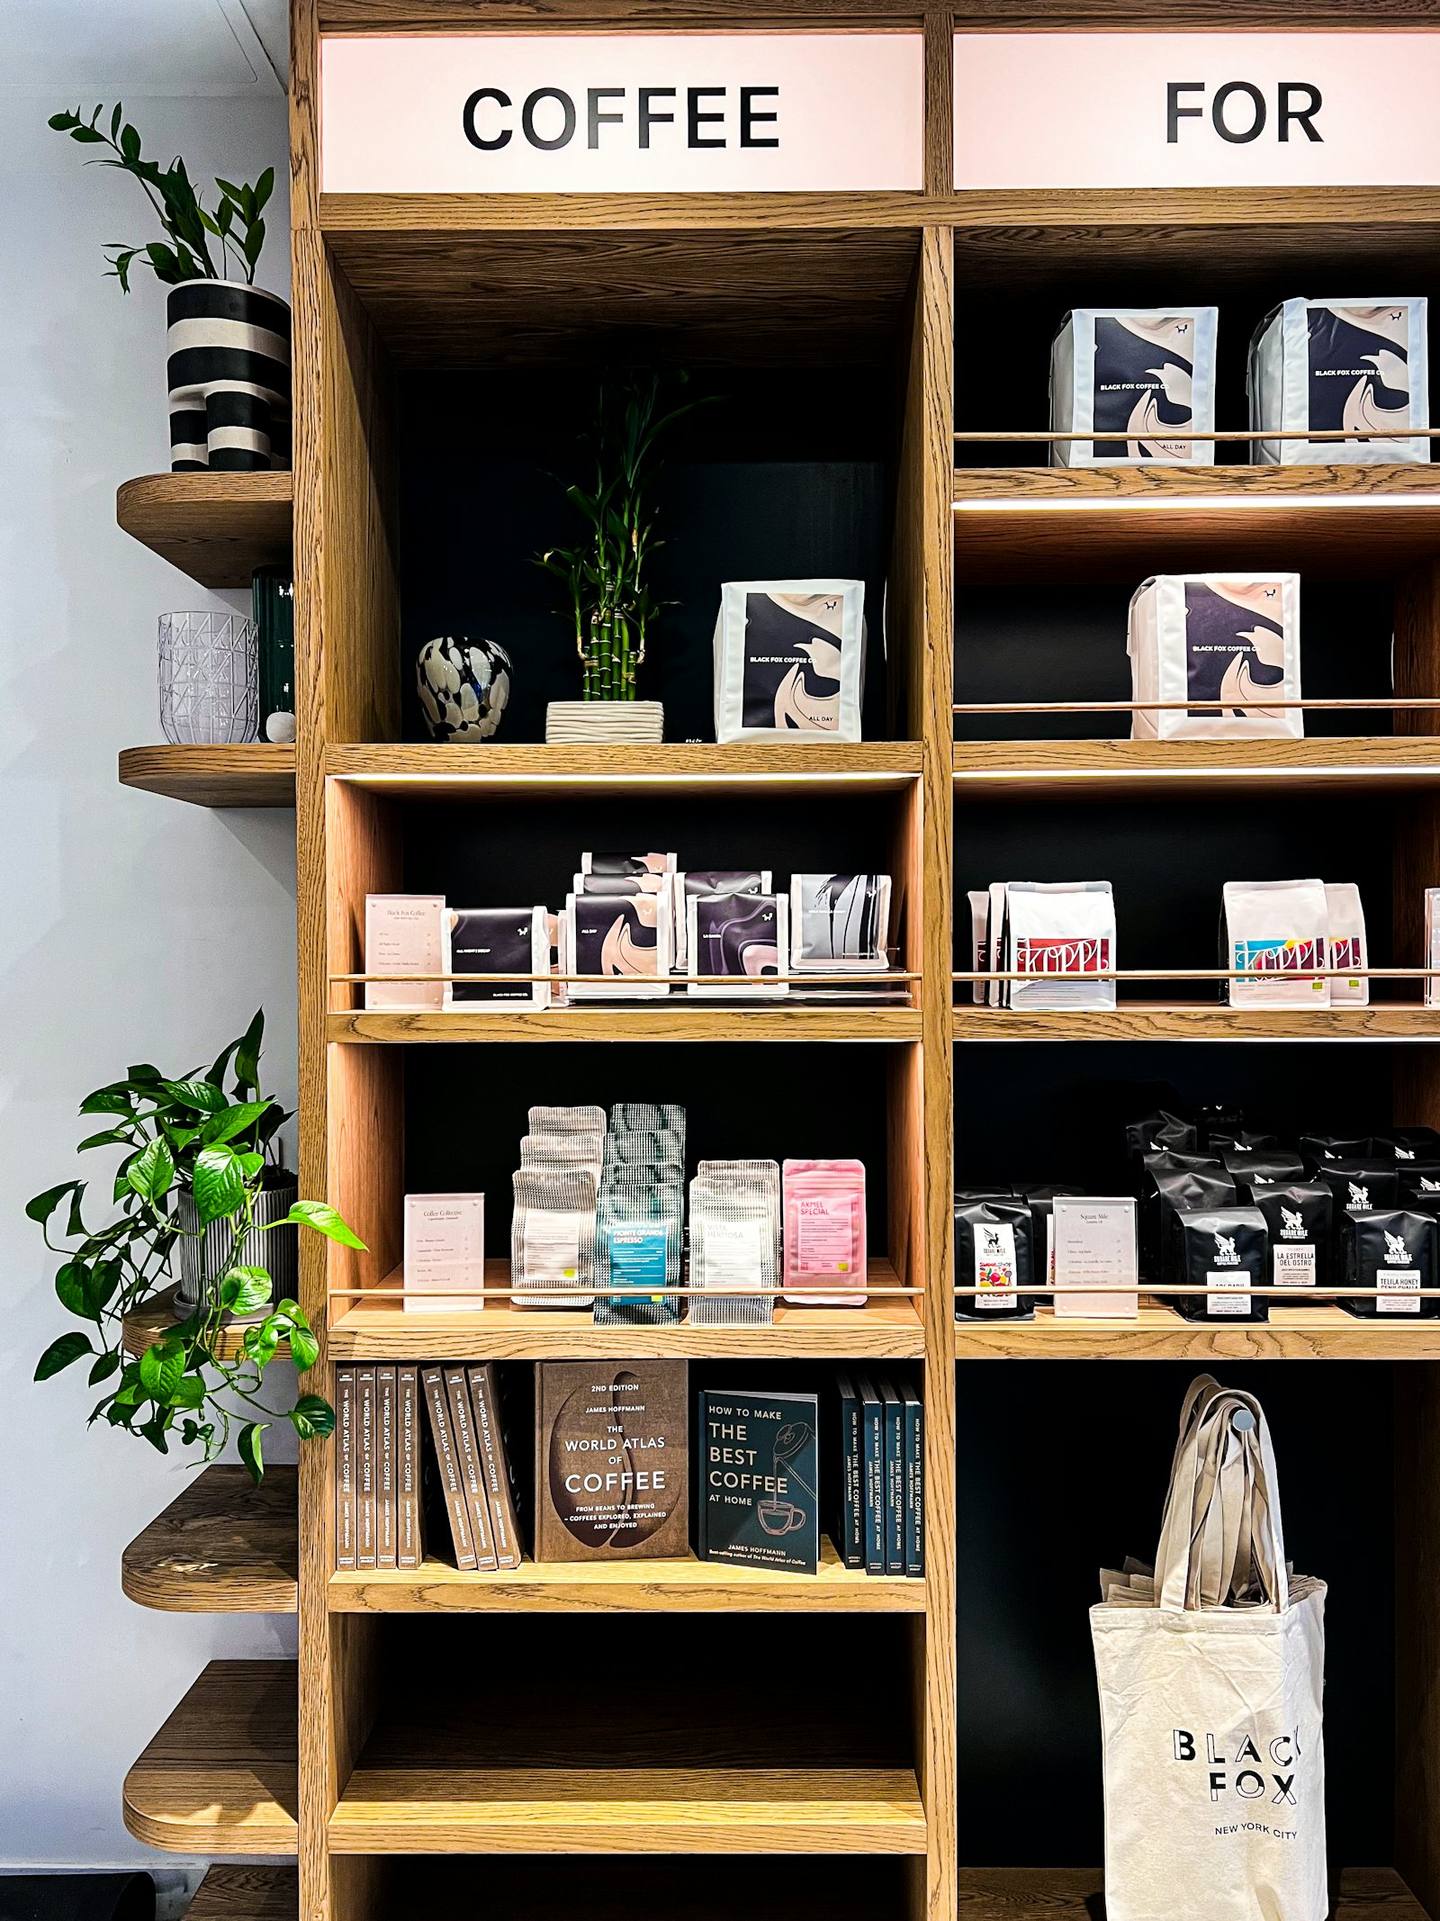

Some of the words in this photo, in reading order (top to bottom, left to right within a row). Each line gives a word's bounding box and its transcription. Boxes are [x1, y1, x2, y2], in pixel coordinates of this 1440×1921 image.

[461, 86, 780, 152] COFFEE
[1165, 81, 1325, 144] FOR
[479, 1400, 488, 1428] WORLD
[709, 1405, 732, 1415] HOW
[736, 1408, 749, 1417] TO
[754, 1410, 782, 1420] MAKE
[483, 1430, 492, 1452] ATLAS
[709, 1422, 747, 1441] THE
[435, 1400, 445, 1427] WORLD
[440, 1430, 450, 1452] ATLAS
[446, 1463, 458, 1492] COFFEE
[457, 1401, 466, 1428] WORLD
[462, 1430, 471, 1453] ATLAS
[468, 1464, 478, 1493] COFFEE
[565, 1439, 617, 1452] WORLD
[622, 1437, 665, 1449] ATLAS
[710, 1446, 757, 1466] BEST
[489, 1463, 498, 1492] COFFEE
[565, 1471, 666, 1494] COFFEE
[710, 1471, 788, 1494] COFFEE
[724, 1496, 752, 1506] HOME
[750, 1547, 786, 1556] HOFFMANN
[1209, 1770, 1297, 1805] FOX
[1215, 1824, 1238, 1835] NEW
[1241, 1822, 1270, 1834] YORK
[1273, 1829, 1298, 1839] CITY
